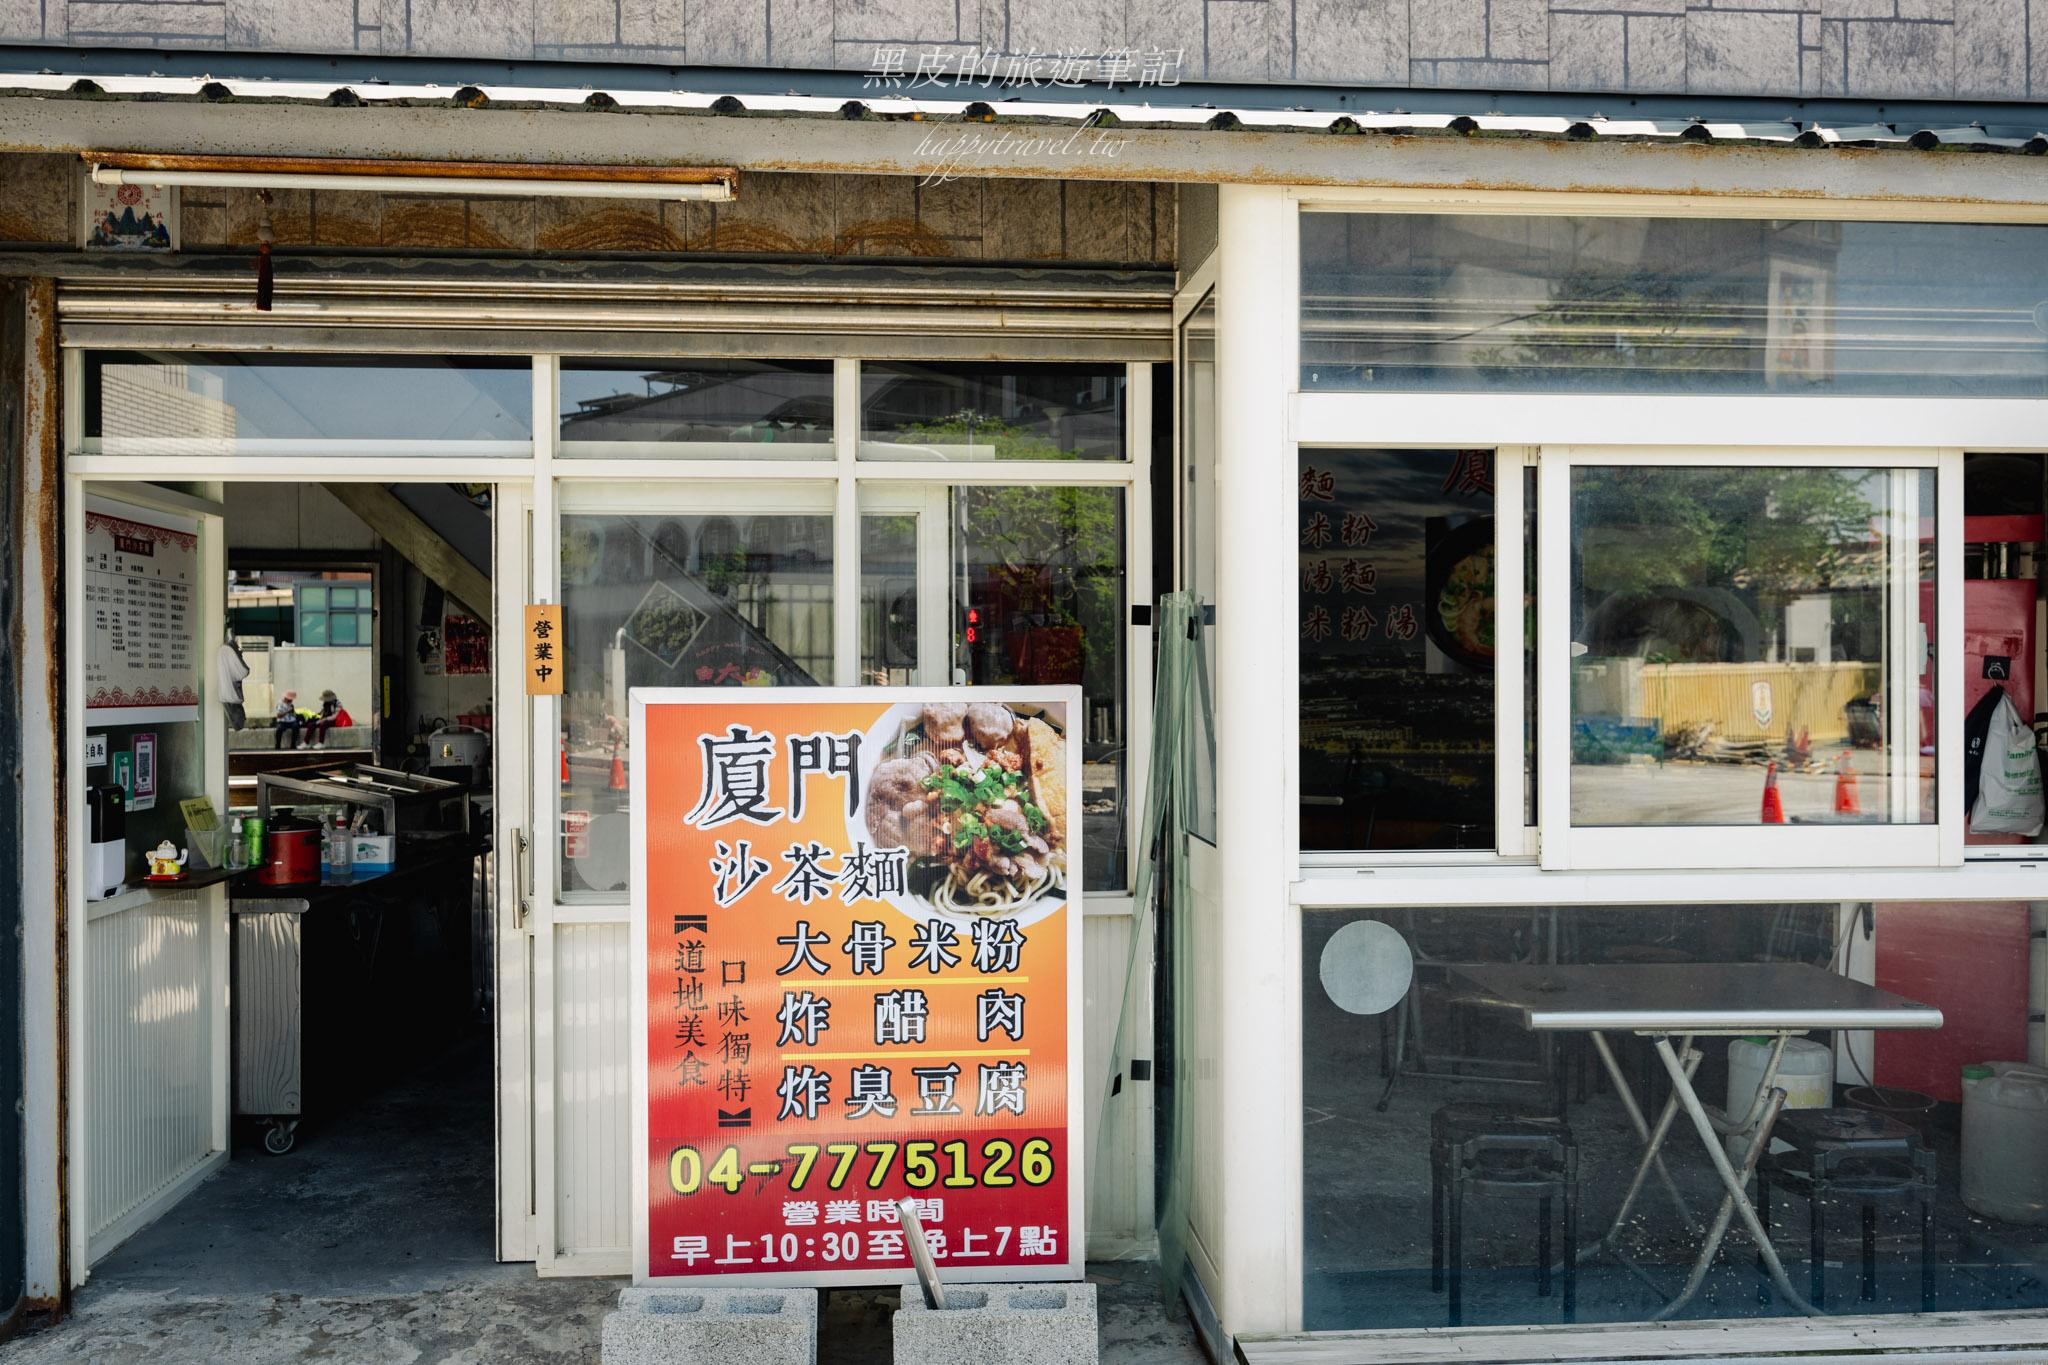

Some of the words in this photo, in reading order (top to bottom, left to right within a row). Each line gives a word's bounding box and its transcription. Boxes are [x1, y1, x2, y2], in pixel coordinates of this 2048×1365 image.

[1302, 512, 1378, 547] 米粉
[1303, 557, 1377, 595] 湯麵
[1302, 603, 1418, 641] 米粉湯
[533, 620, 553, 682] 營業中
[86, 743, 104, 759] 自取
[686, 727, 864, 827] 廈門
[711, 841, 909, 906] 沙茶麵
[777, 918, 1025, 975] 大骨米粉
[777, 988, 1025, 1047] 炸醋肉
[777, 1062, 1028, 1120] 炸臭豆腐
[669, 1138, 1056, 1195] 04-7775126
[782, 1198, 944, 1227] 營業時間
